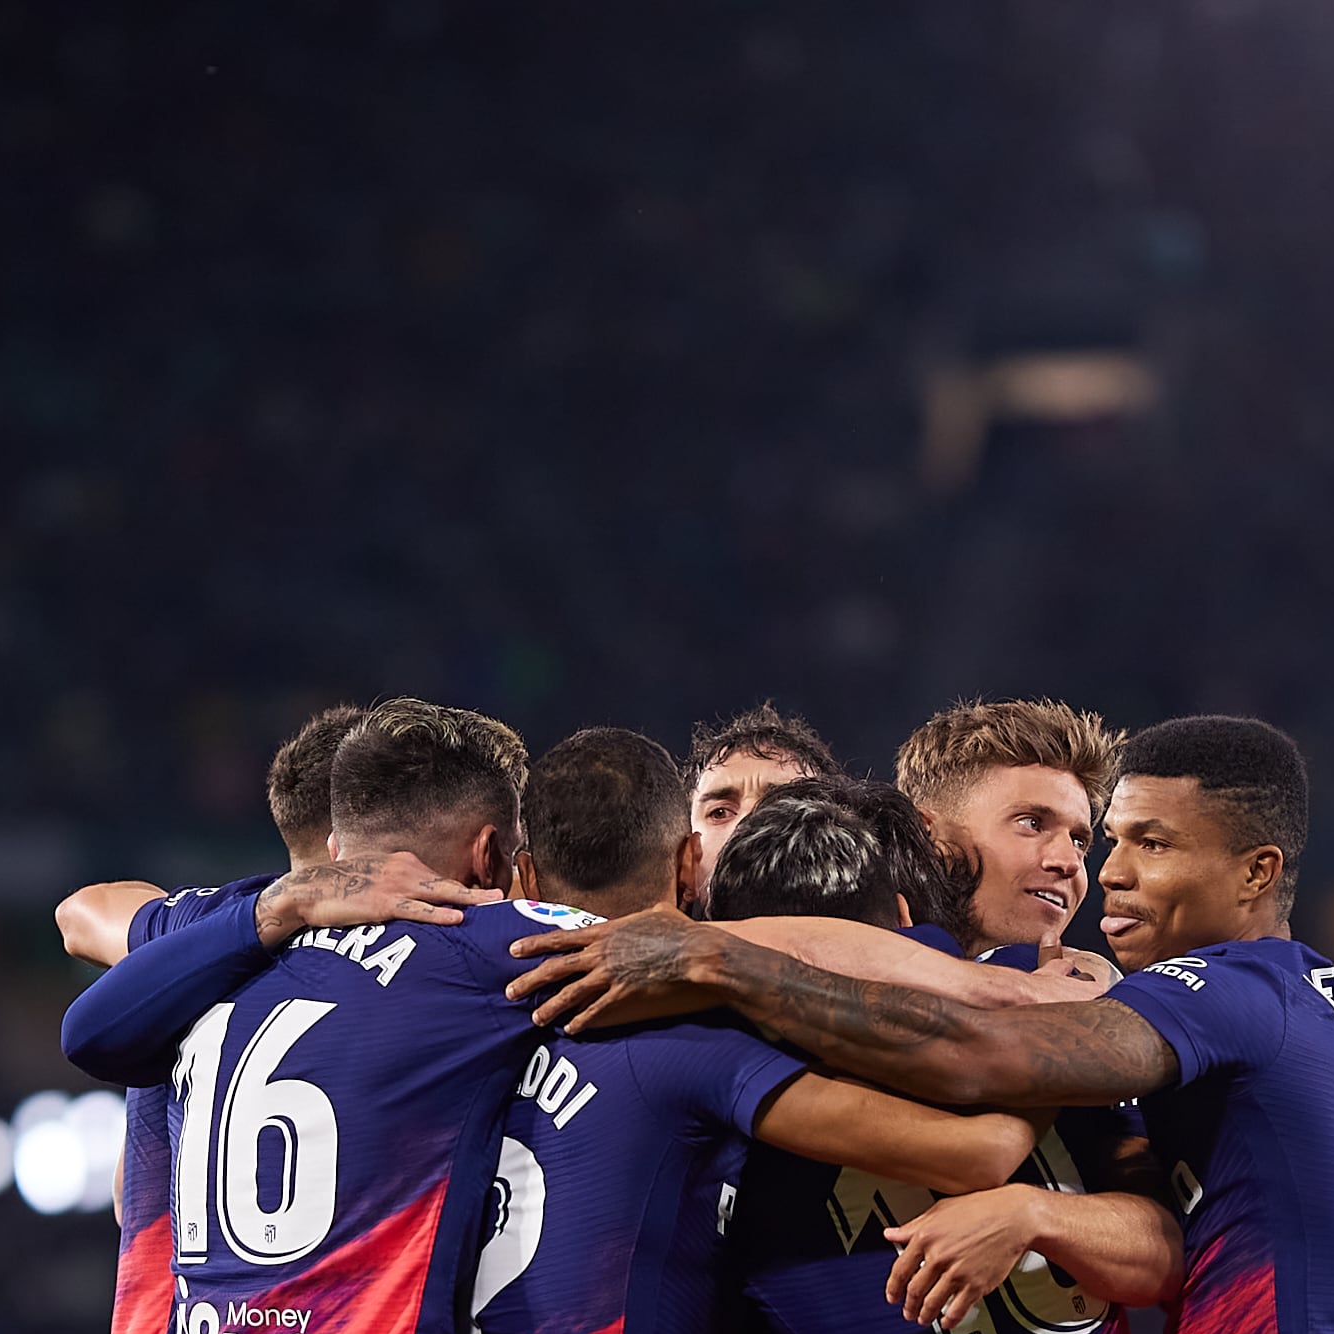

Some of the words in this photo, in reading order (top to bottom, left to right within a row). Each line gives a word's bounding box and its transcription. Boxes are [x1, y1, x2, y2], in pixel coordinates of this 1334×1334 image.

[1143, 965, 1206, 992] NDAI
[516, 1045, 598, 1130] ODI
[172, 999, 338, 1266] 16
[226, 1301, 312, 1334] Money
